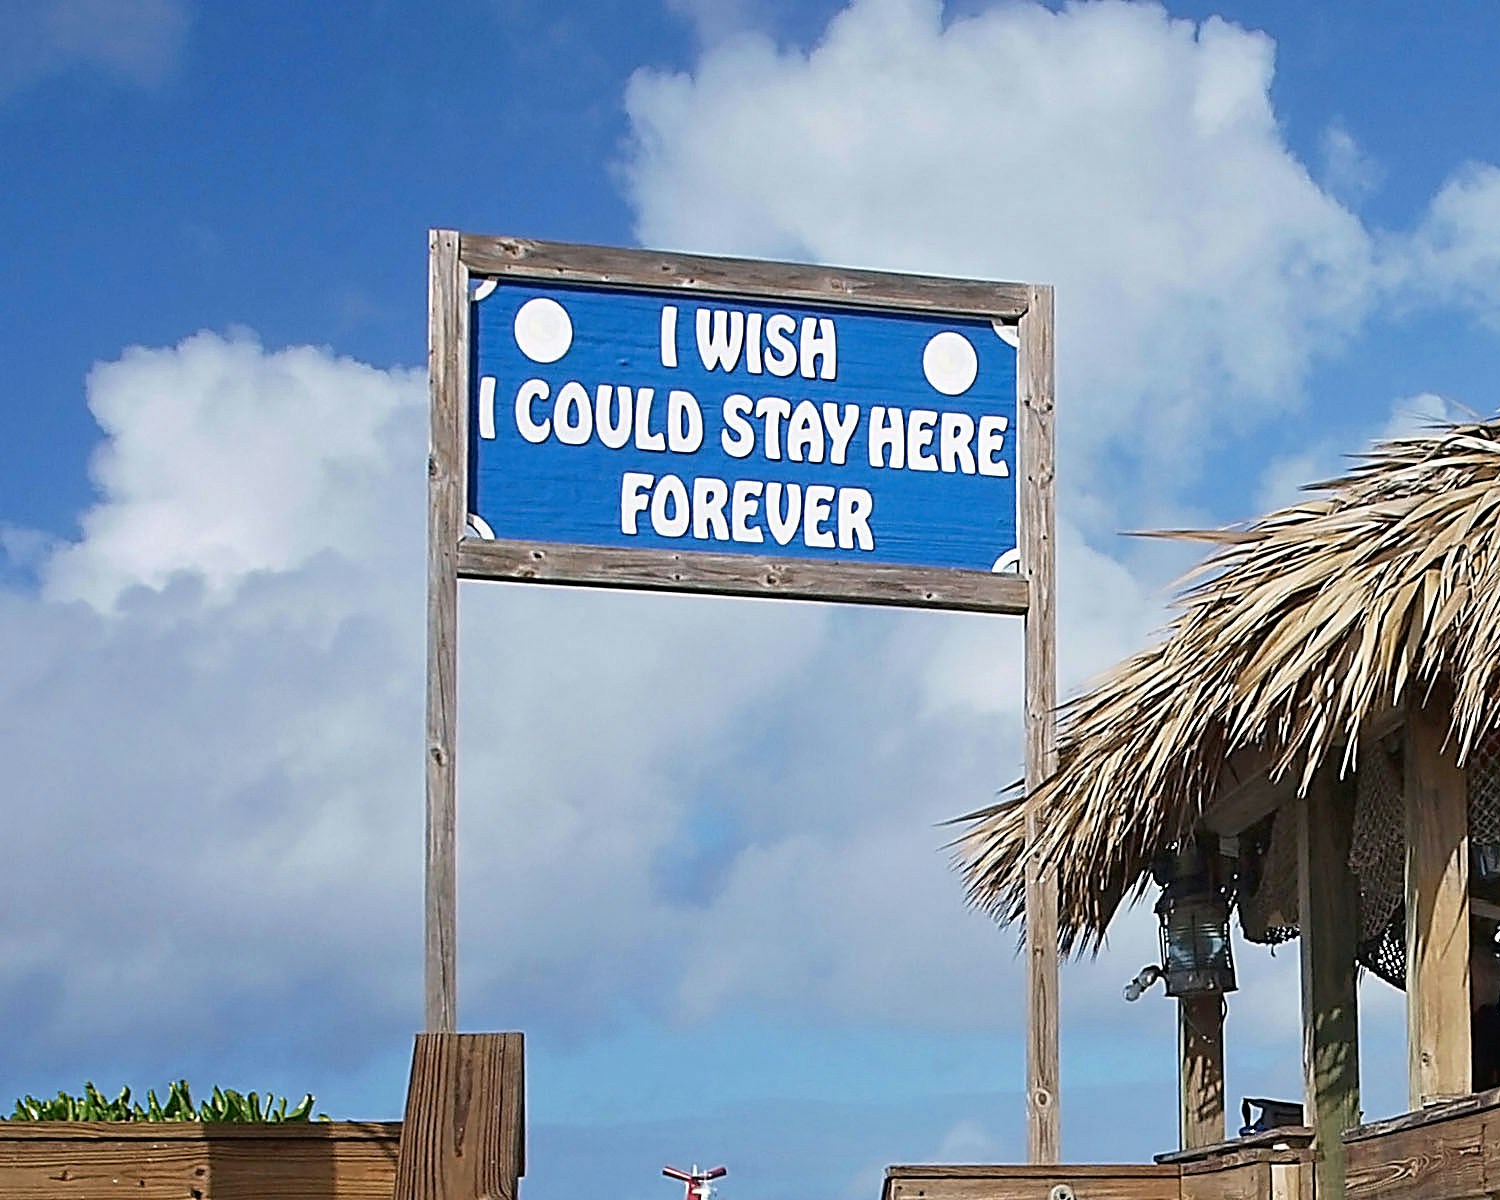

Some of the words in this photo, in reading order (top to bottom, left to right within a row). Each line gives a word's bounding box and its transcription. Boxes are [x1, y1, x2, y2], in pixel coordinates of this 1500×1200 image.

[661, 306, 678, 368] I
[695, 308, 838, 380] WISH
[478, 376, 496, 439] I
[515, 378, 703, 453] COULD
[721, 394, 860, 465] STAY
[868, 406, 1009, 477] HERE
[620, 472, 874, 551] FOREVER
